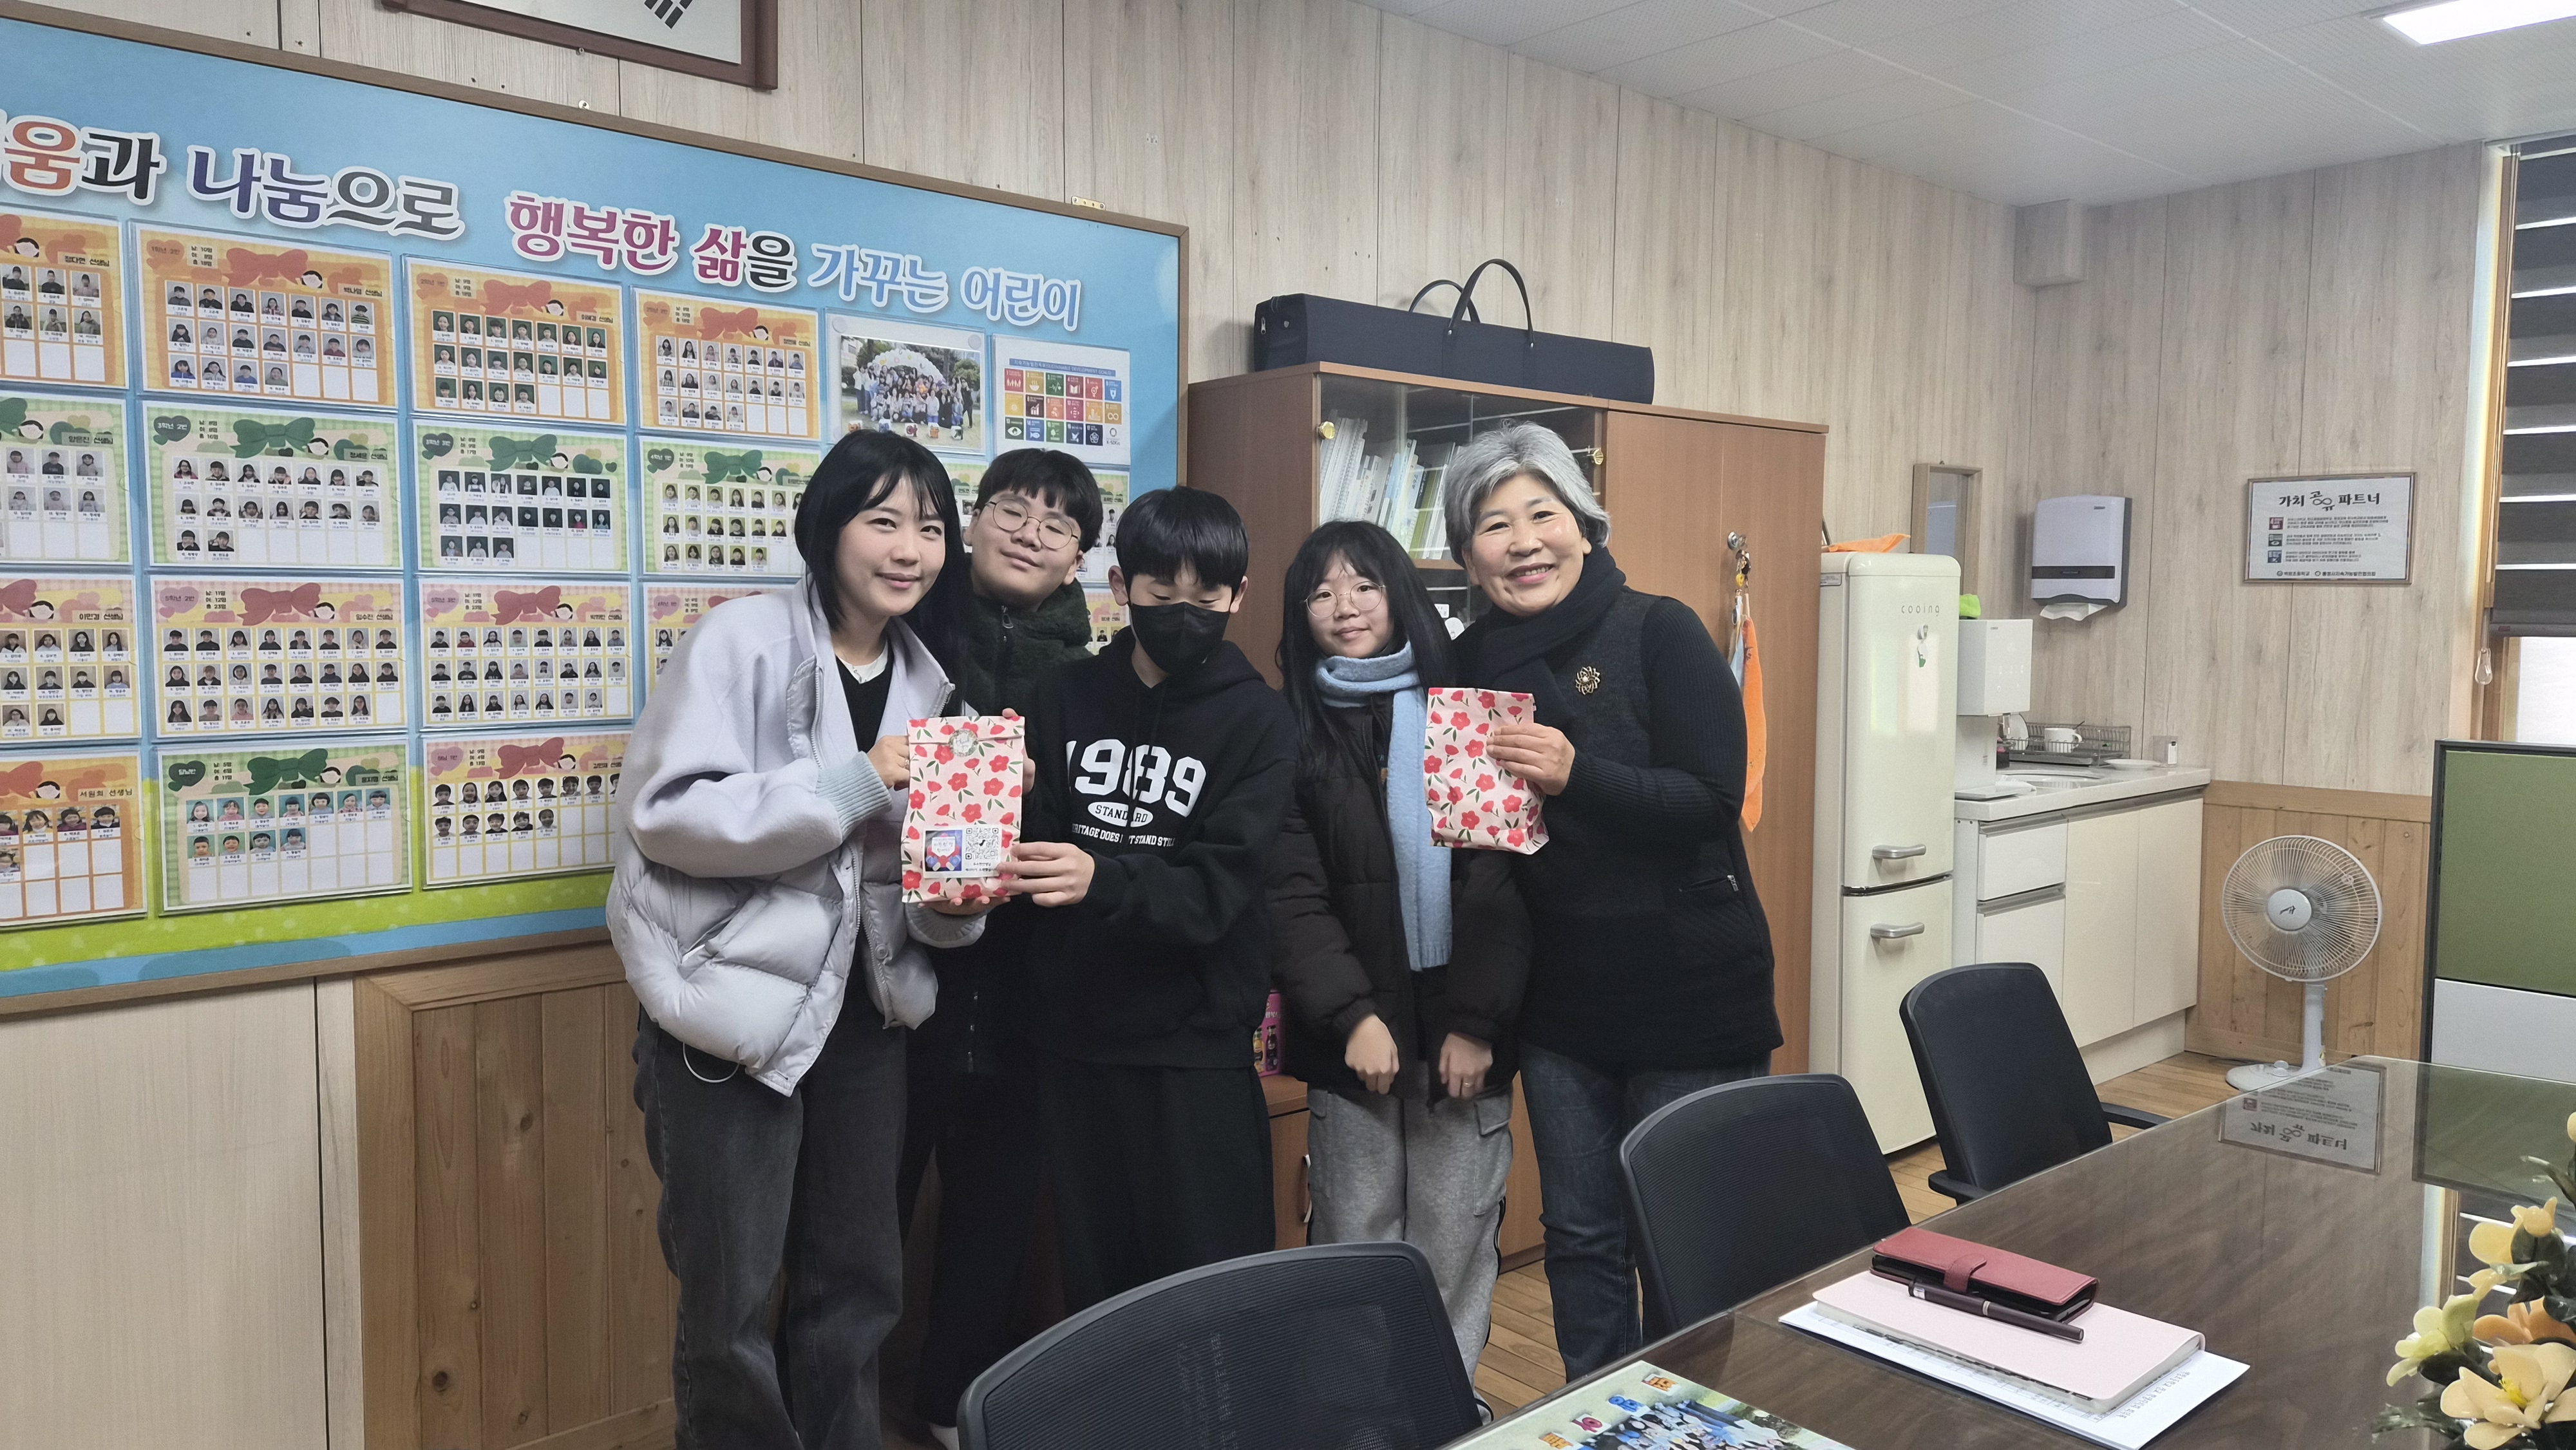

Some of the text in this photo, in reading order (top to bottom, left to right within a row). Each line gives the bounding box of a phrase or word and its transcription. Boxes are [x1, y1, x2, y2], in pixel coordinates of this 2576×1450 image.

[1, 120, 1081, 330] 움과 나눔으로 행복한 삶을 가꾸는 어린이
[89, 258, 110, 267] 선생님
[365, 288, 383, 297] 선생님
[2279, 494, 2306, 507] 가치
[2338, 493, 2380, 505] 파트너
[1901, 603, 1940, 617] cooing
[109, 788, 133, 796] 선생님
[1095, 805, 1148, 824] STANDRD
[1100, 829, 1121, 843] DOES
[1134, 835, 1157, 846] STAND
[1158, 836, 1175, 847] STILL
